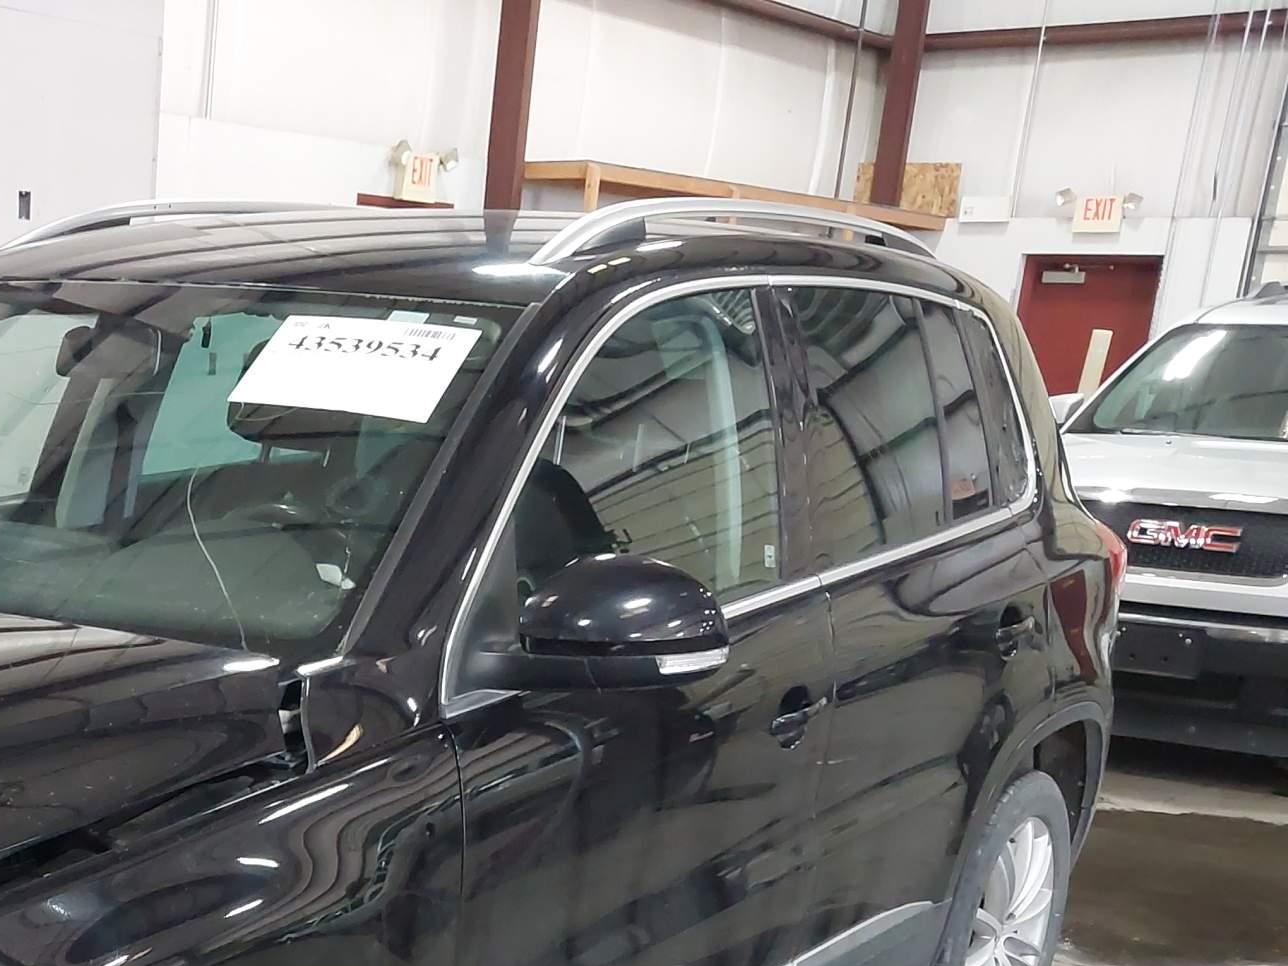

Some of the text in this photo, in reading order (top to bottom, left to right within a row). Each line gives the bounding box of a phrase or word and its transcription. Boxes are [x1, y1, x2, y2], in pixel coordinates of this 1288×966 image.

[411, 155, 433, 187] EXIT
[1083, 198, 1116, 221] EXIT
[288, 335, 442, 362] 43539534
[1127, 518, 1244, 554] GMC
